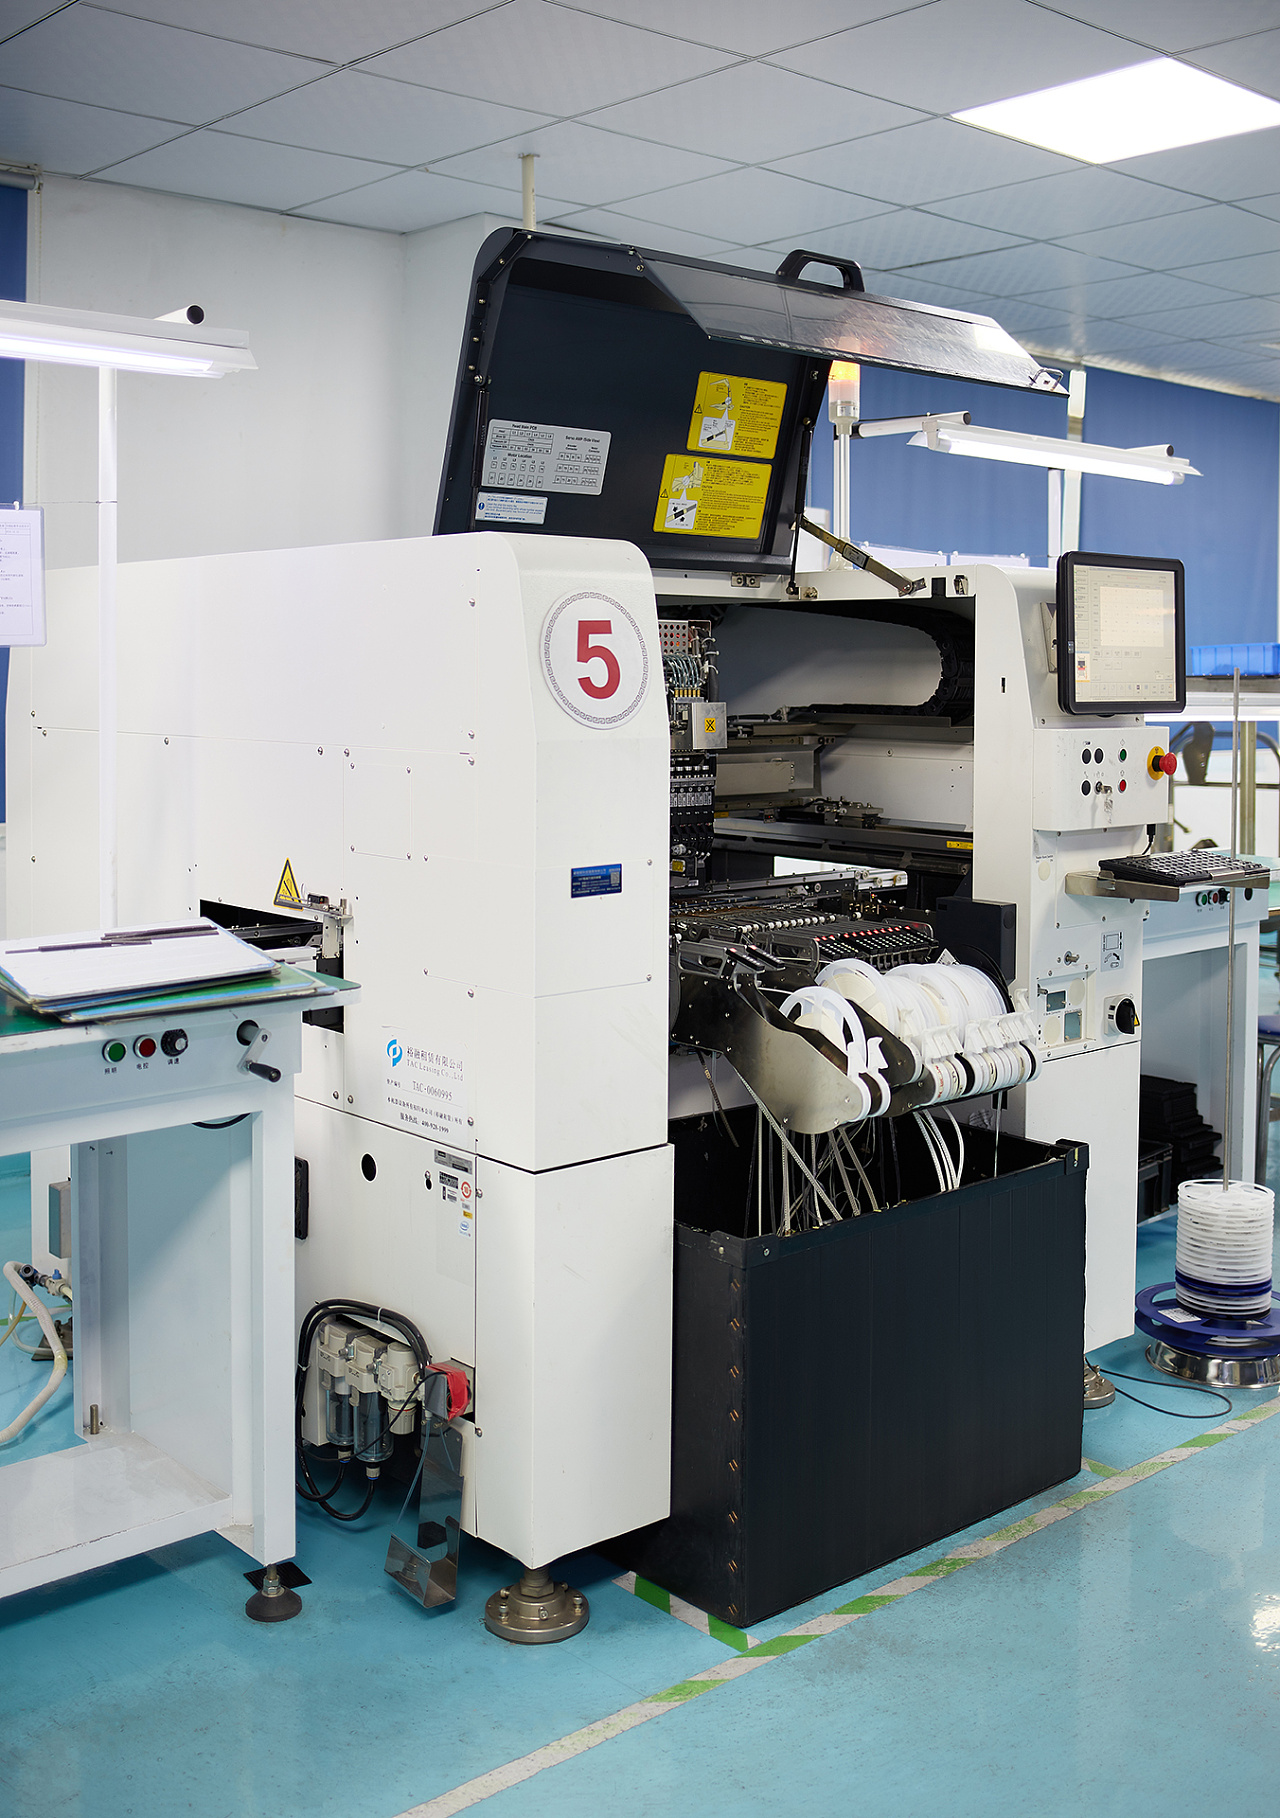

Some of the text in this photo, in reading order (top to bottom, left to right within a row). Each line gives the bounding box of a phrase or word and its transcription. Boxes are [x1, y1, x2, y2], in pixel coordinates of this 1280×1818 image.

[577, 620, 620, 700] 5
[407, 1046, 463, 1071] 裕融租赁有限公司
